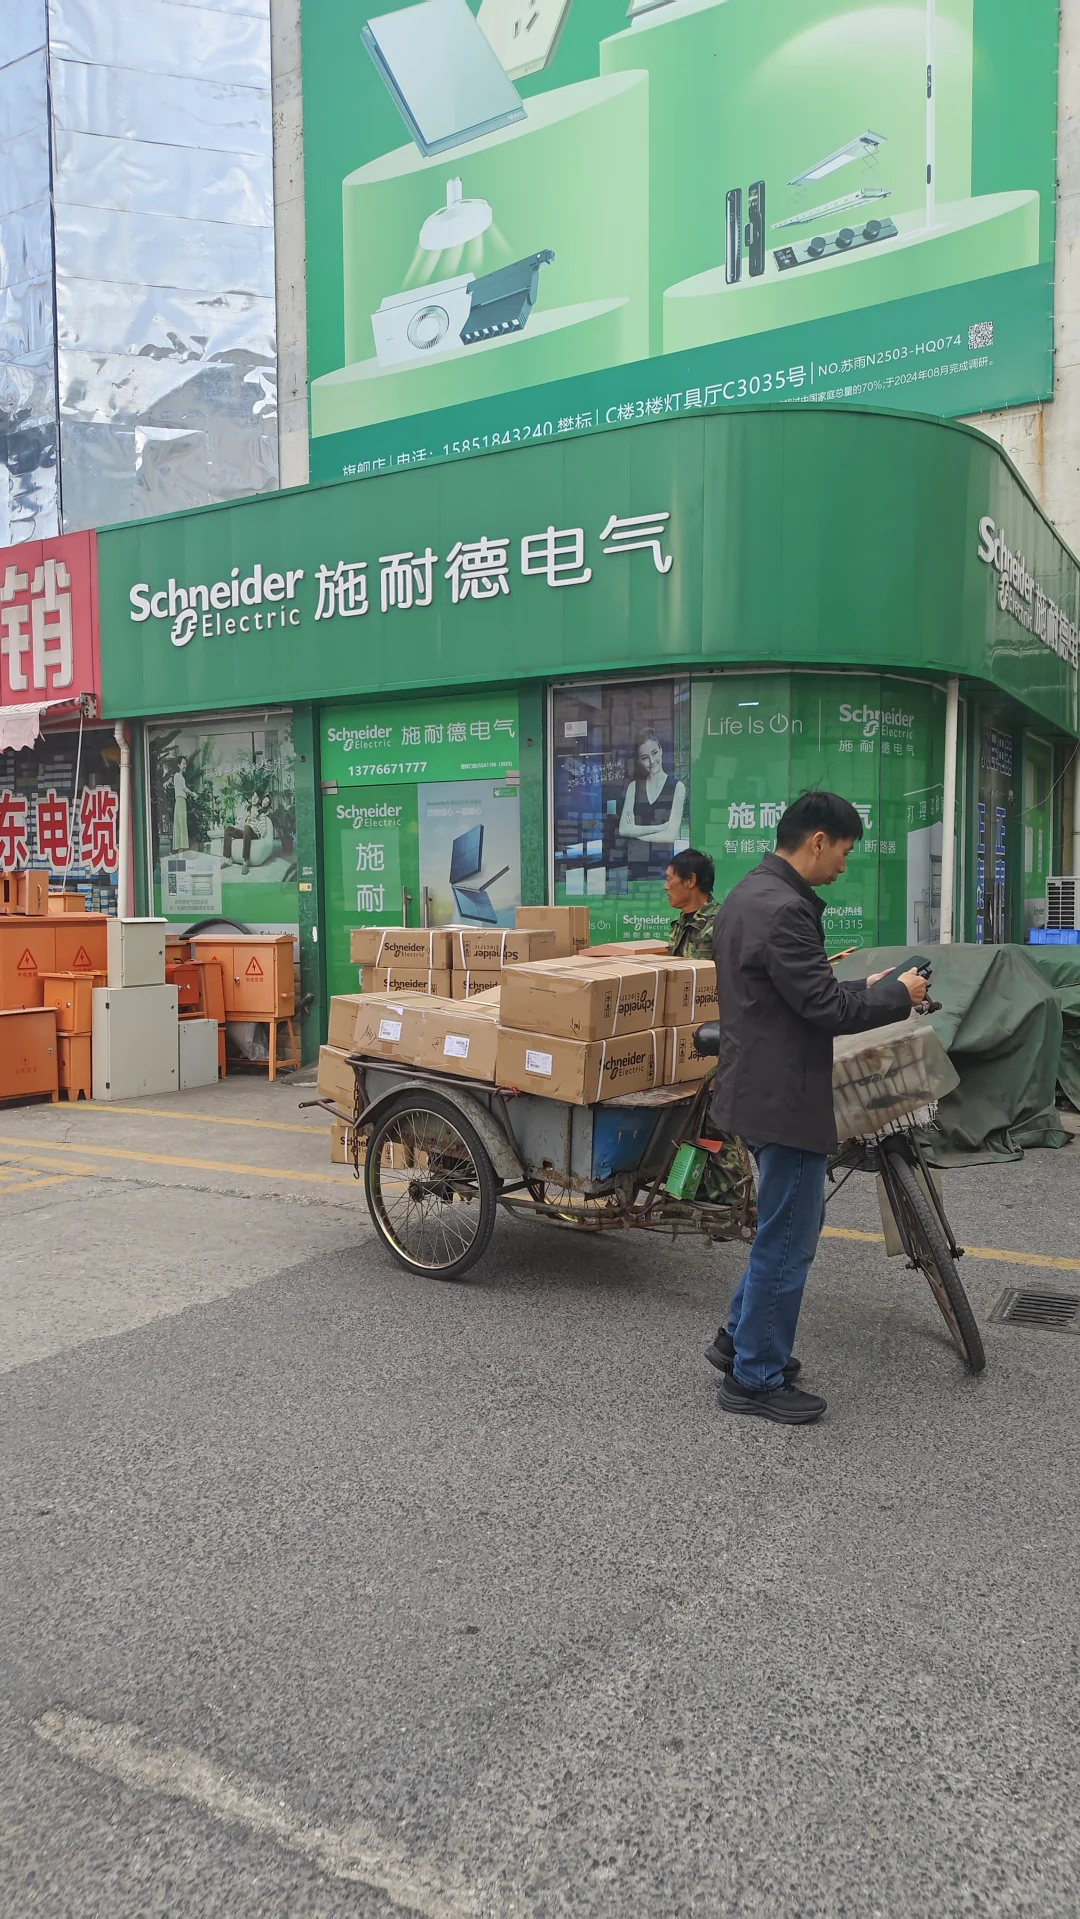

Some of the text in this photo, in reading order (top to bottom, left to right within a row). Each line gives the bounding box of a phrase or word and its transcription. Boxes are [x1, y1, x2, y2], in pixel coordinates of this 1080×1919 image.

[314, 511, 674, 621] 施耐德电气
[977, 516, 1036, 604] Schneider
[129, 563, 304, 623] Schneider
[0, 558, 74, 692] 销
[202, 606, 301, 638] Electric
[1034, 583, 1080, 671] 施耐德电
[707, 712, 803, 736] Life Is On
[839, 704, 915, 728] Schneider
[327, 724, 393, 742] Schneider
[401, 718, 515, 746] 施耐德电气
[881, 726, 914, 740] Electric
[355, 740, 392, 750] Electric
[838, 739, 915, 757] 施耐德电气
[348, 761, 428, 777] 13776671777
[336, 803, 402, 820] Schneider
[727, 802, 873, 830] 施耐气
[0, 788, 118, 869] 东电缆
[364, 818, 402, 827] Electric
[865, 839, 897, 854] 断路器
[597, 919, 611, 930] On
[623, 914, 671, 925] Schneider
[822, 919, 863, 930] 10-1315
[384, 942, 425, 952] Schneider
[401, 950, 425, 958] Electric
[383, 978, 428, 988] Schneider
[619, 1065, 645, 1077] Electric
